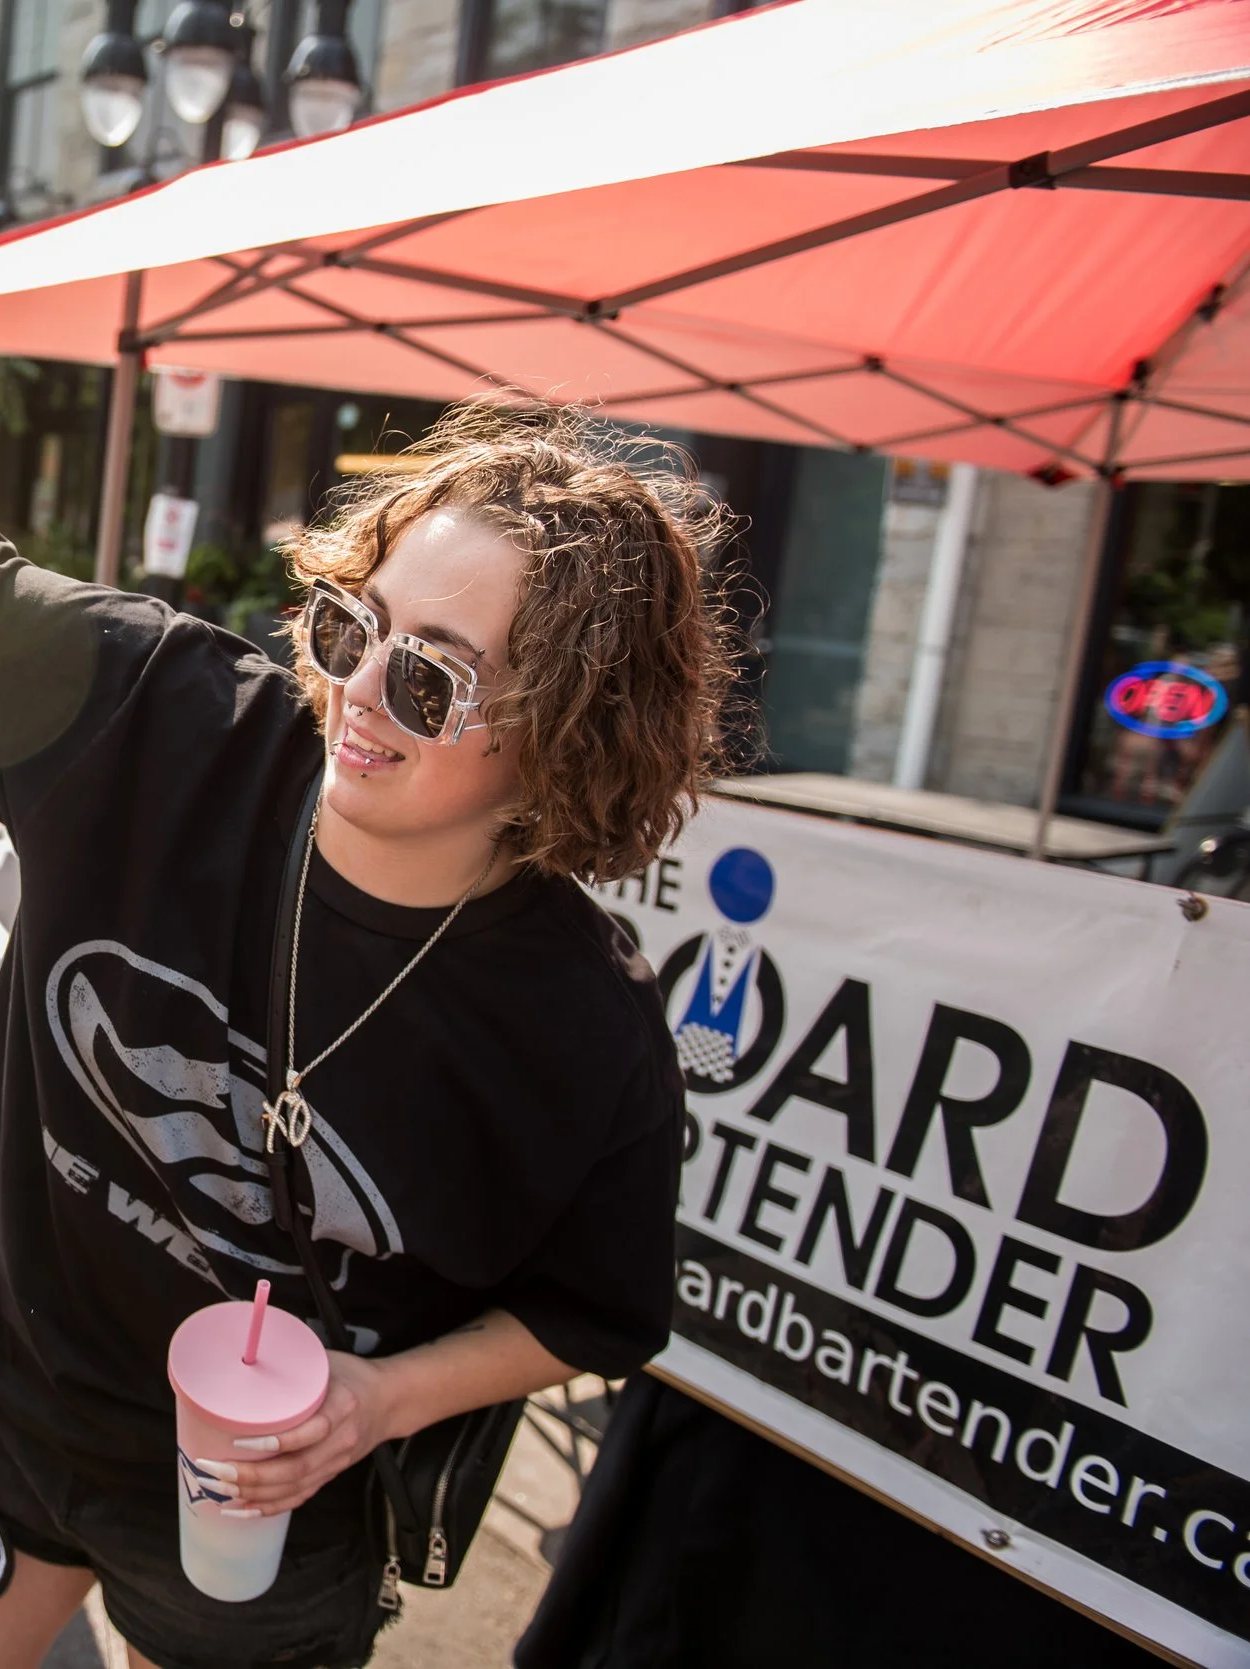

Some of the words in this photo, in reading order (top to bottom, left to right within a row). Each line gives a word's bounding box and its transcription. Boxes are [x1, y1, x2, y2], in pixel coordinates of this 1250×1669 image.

[1111, 677, 1218, 723] OPEN
[599, 856, 682, 913] HE
[606, 908, 1210, 1252] OARD
[680, 1110, 1154, 1408] TENDER
[676, 1258, 1250, 1591] ardbartender.c
